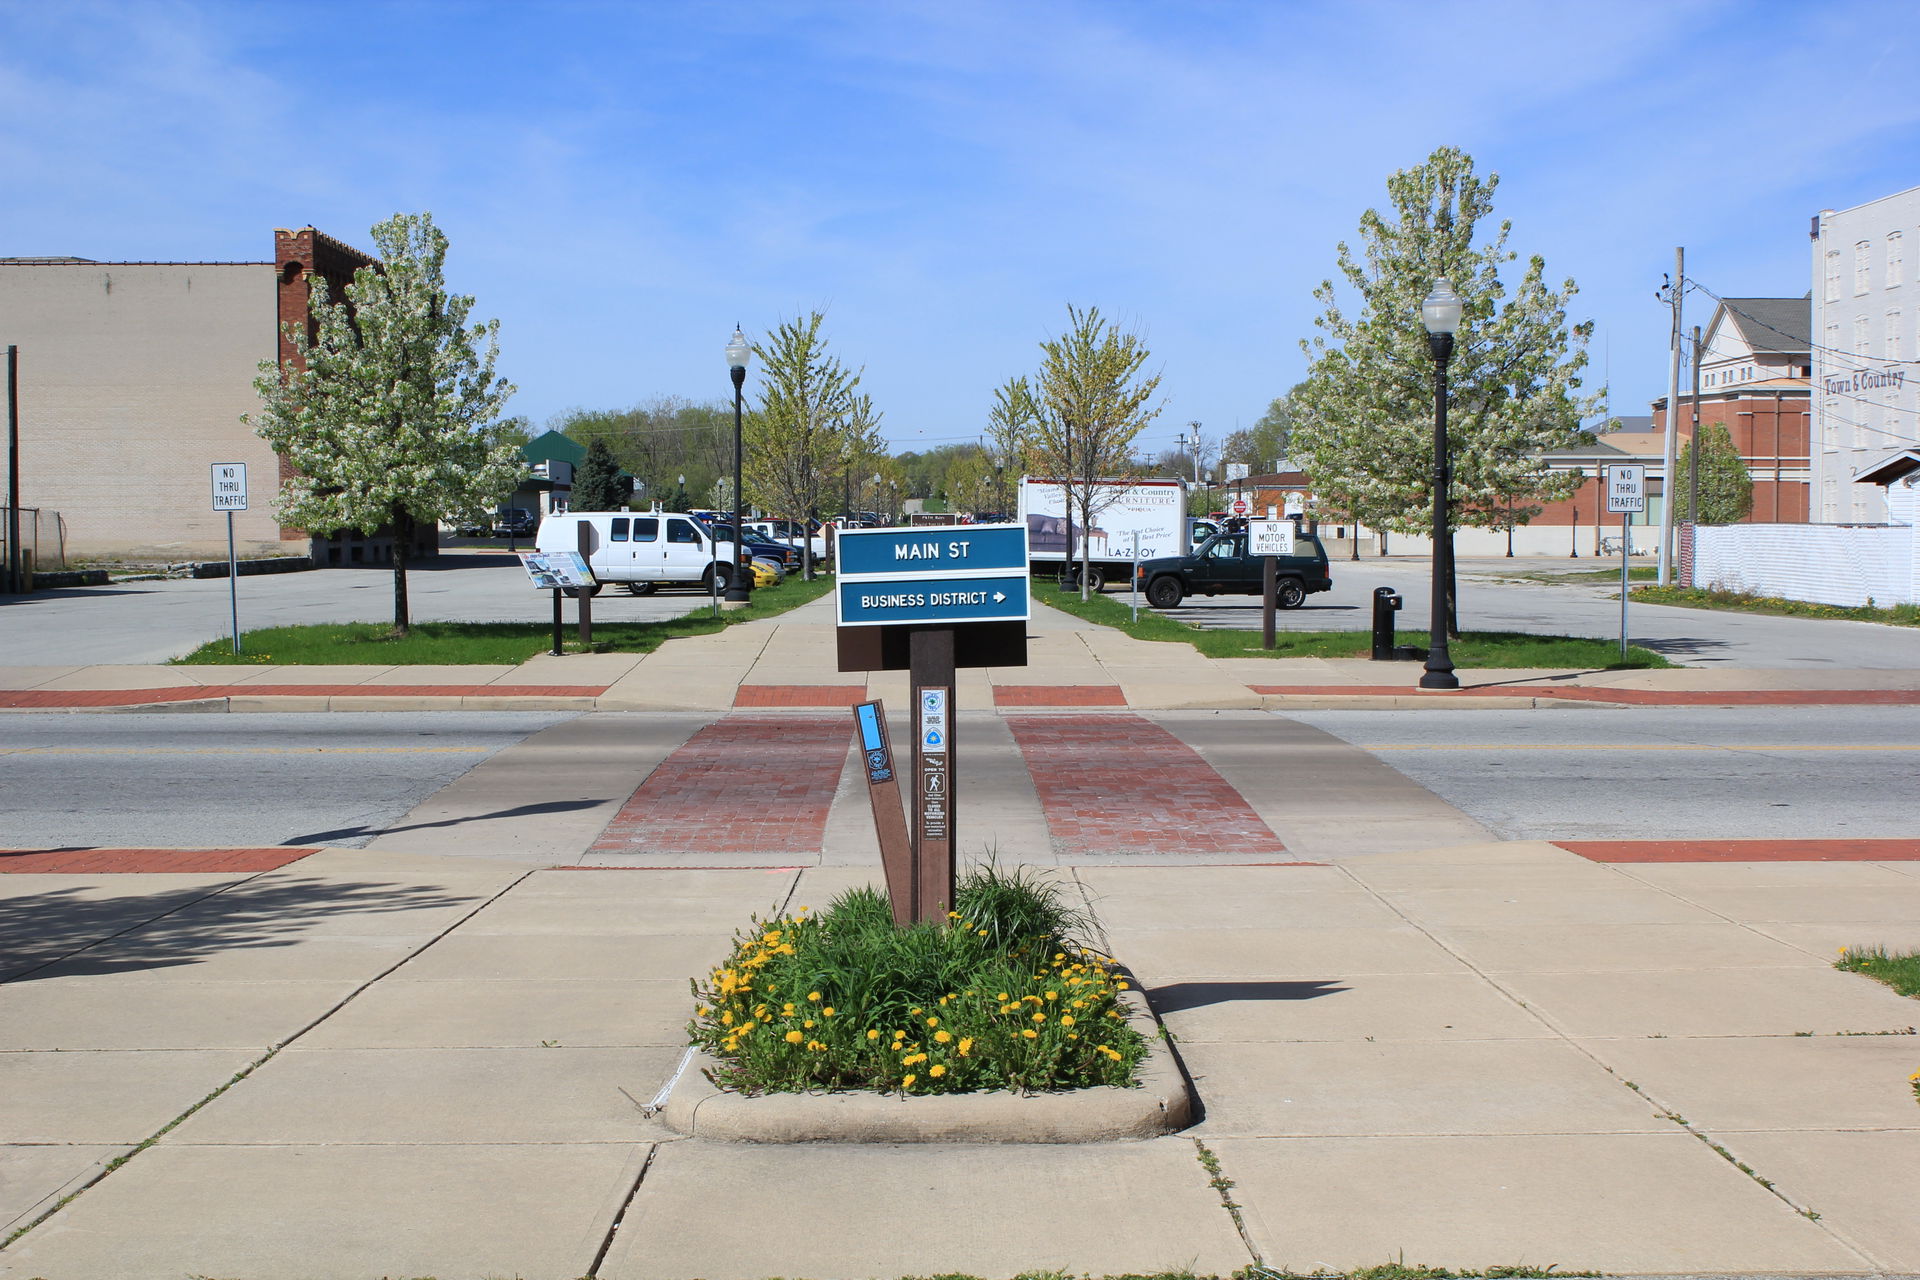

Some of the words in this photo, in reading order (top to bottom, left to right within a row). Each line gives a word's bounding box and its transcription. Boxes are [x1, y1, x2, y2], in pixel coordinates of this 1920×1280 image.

[1824, 378, 1851, 396] Town
[1853, 374, 1859, 392] &
[1861, 368, 1905, 390] Country
[222, 468, 235, 478] NO
[1620, 470, 1632, 480] NO
[219, 482, 239, 492] THRU
[1616, 483, 1636, 494] THRU
[1141, 488, 1176, 498] Country
[215, 495, 246, 506] TRAFFIC
[1610, 497, 1642, 508] TRAFFIC
[1266, 523, 1278, 533] NO
[1258, 533, 1286, 543] MOTOR
[895, 543, 940, 560] MAIN
[948, 541, 970, 559] ST
[1108, 548, 1156, 557] LA-Z-OY
[1256, 543, 1288, 552] VEHICLES
[861, 593, 925, 609] BUSINESS
[930, 591, 988, 607] DISTRICT
